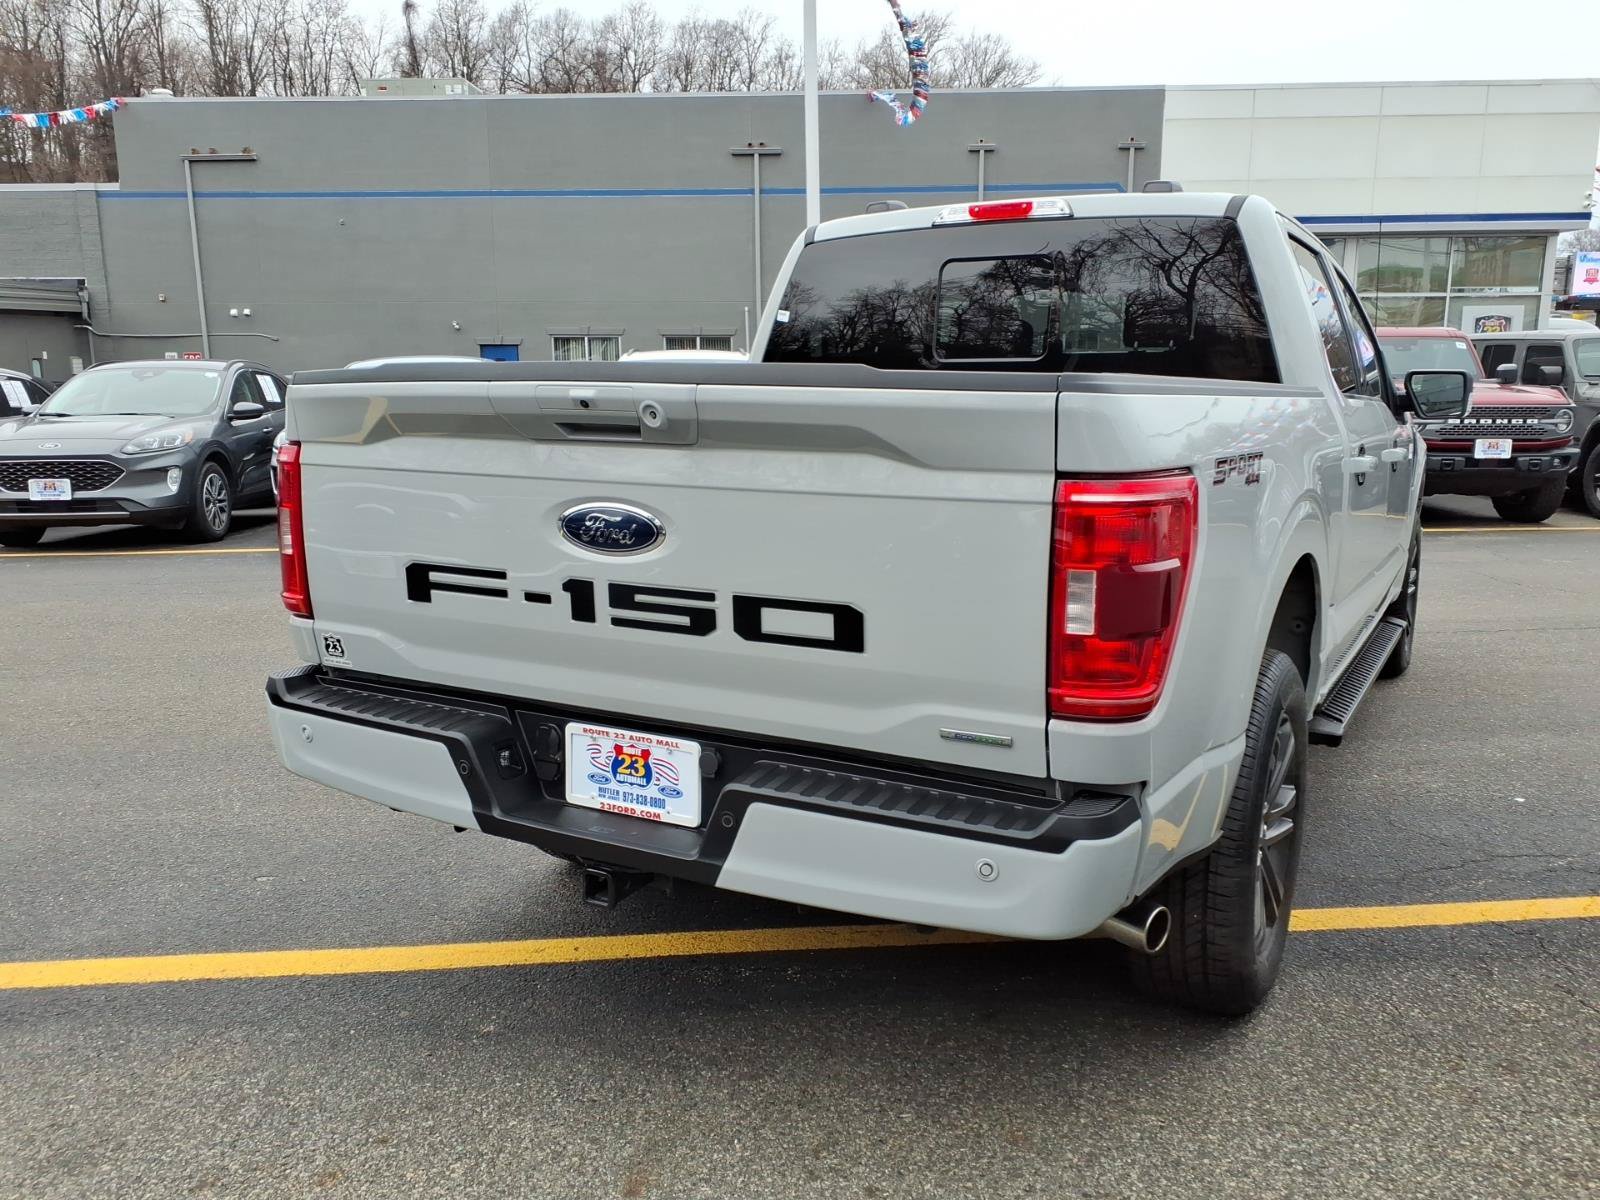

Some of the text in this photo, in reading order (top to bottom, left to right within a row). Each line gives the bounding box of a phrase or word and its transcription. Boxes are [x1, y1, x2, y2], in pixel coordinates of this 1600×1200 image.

[1213, 451, 1264, 486] SPORT
[579, 512, 638, 545] Ford
[404, 561, 865, 654] F-150
[326, 640, 342, 653] 23
[582, 727, 680, 749] ROUTE 23 AUTO MALL
[616, 753, 646, 777] 23
[598, 786, 620, 797] BUTLER
[622, 791, 666, 810] 973-838-0800
[599, 801, 662, 820] 23FORD.COM
